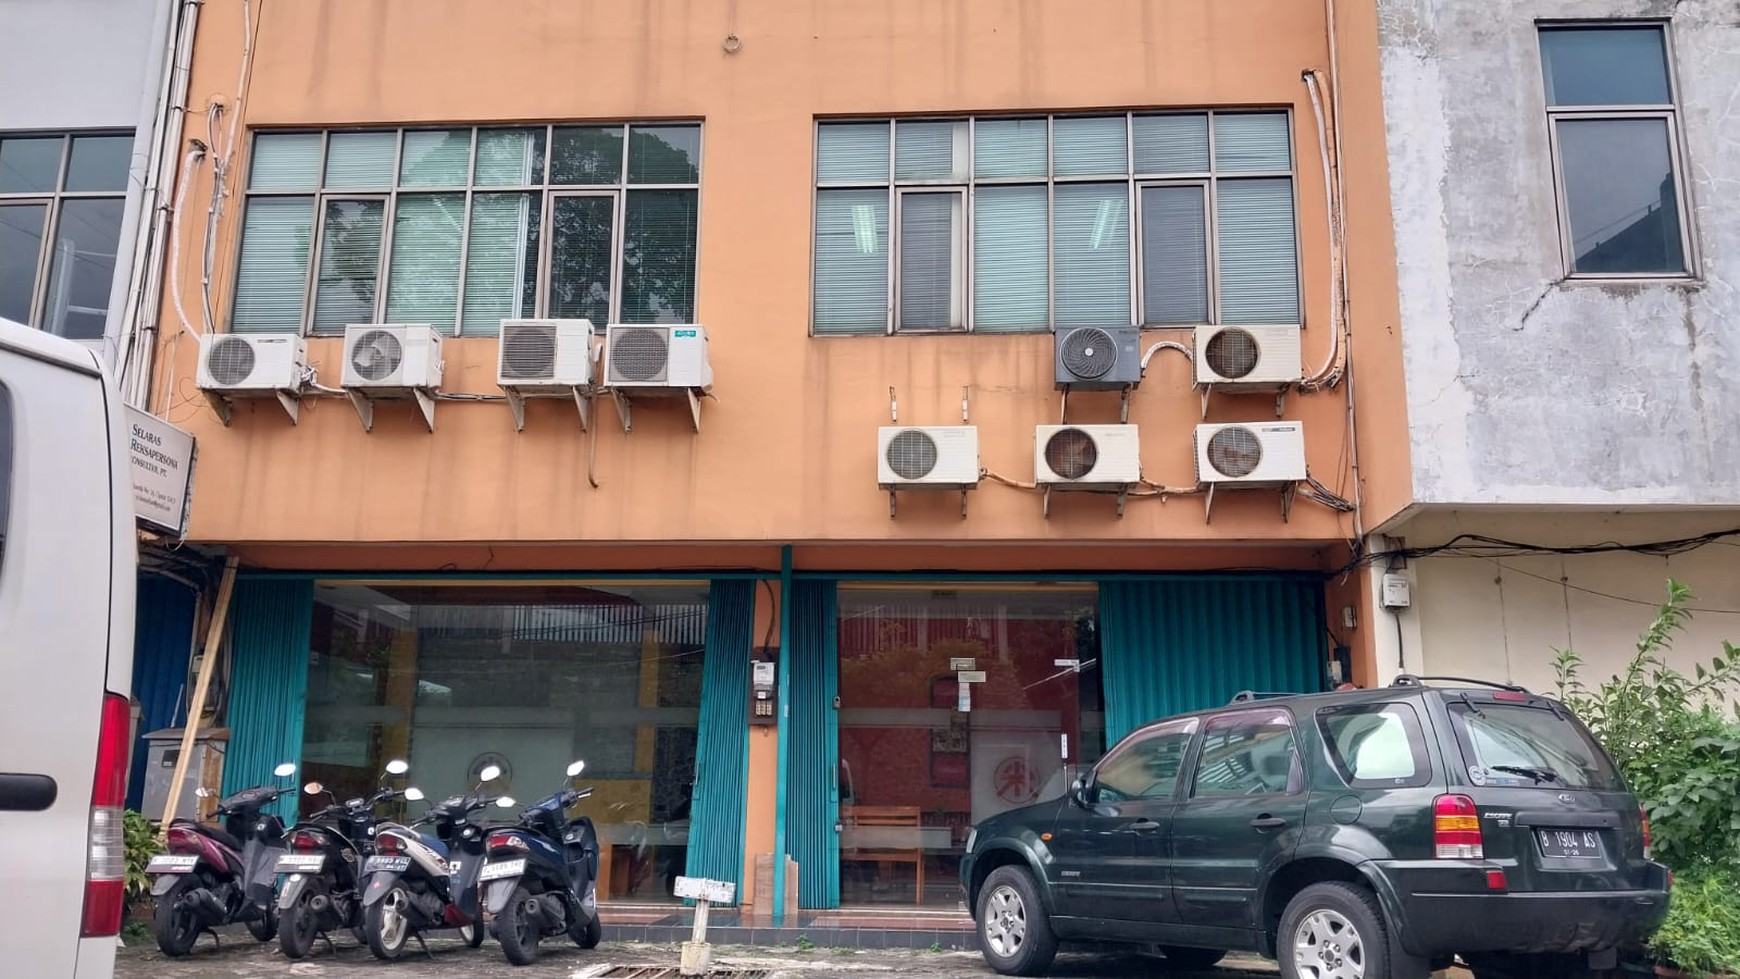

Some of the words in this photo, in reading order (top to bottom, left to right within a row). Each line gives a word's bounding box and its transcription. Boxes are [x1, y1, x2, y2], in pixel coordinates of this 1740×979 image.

[132, 423, 162, 446] SELARAS
[130, 438, 178, 470] REKSAPERSONA
[1541, 830, 1549, 847] B
[1555, 831, 1578, 848] 1904
[1583, 831, 1596, 848] AS
